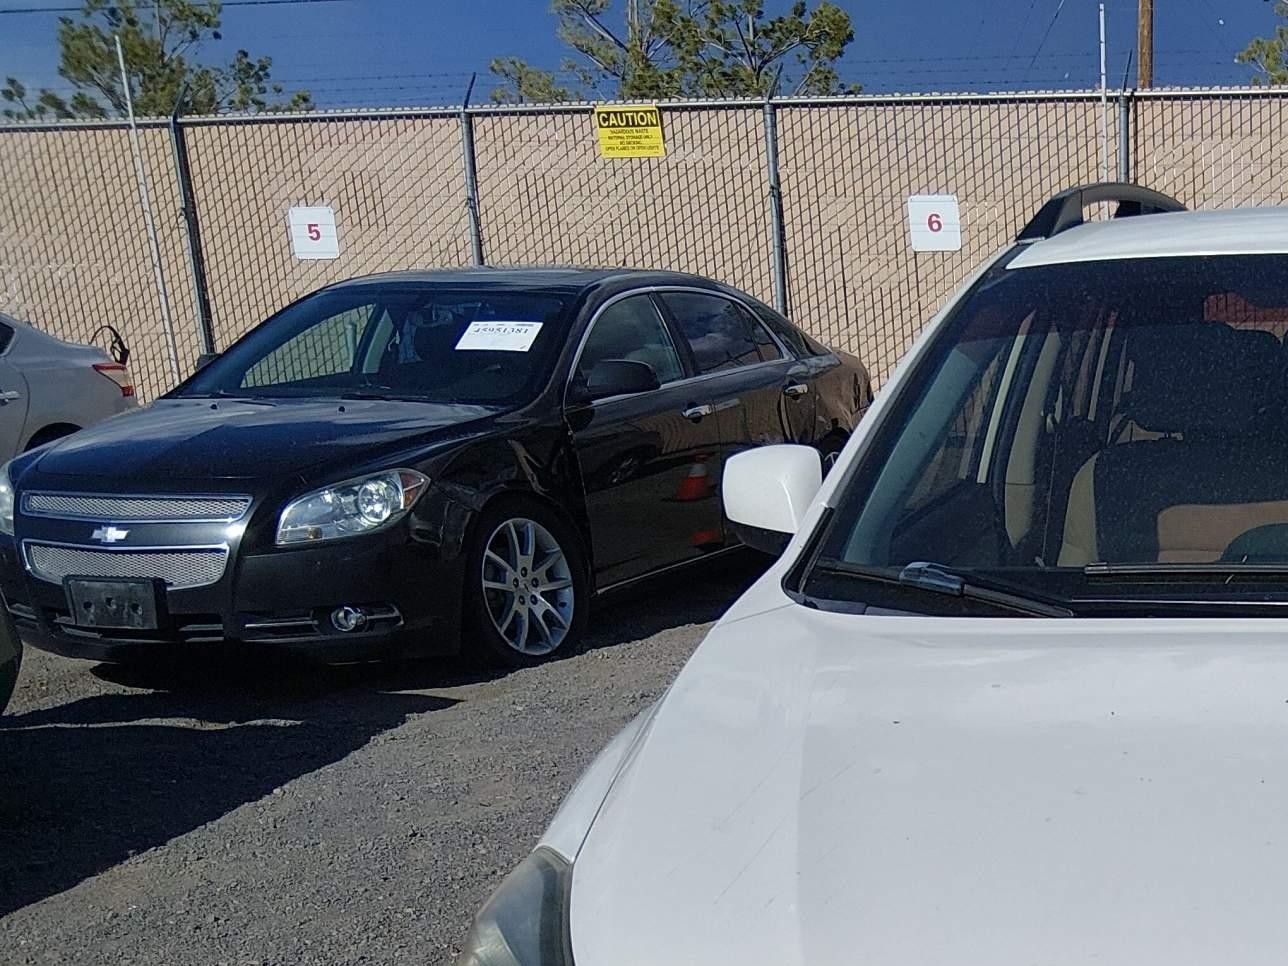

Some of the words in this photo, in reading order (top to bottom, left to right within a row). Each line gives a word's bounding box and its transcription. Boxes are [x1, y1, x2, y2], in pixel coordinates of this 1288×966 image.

[600, 112, 657, 126] CAUTION
[307, 223, 321, 241] 5
[927, 213, 943, 233] 6
